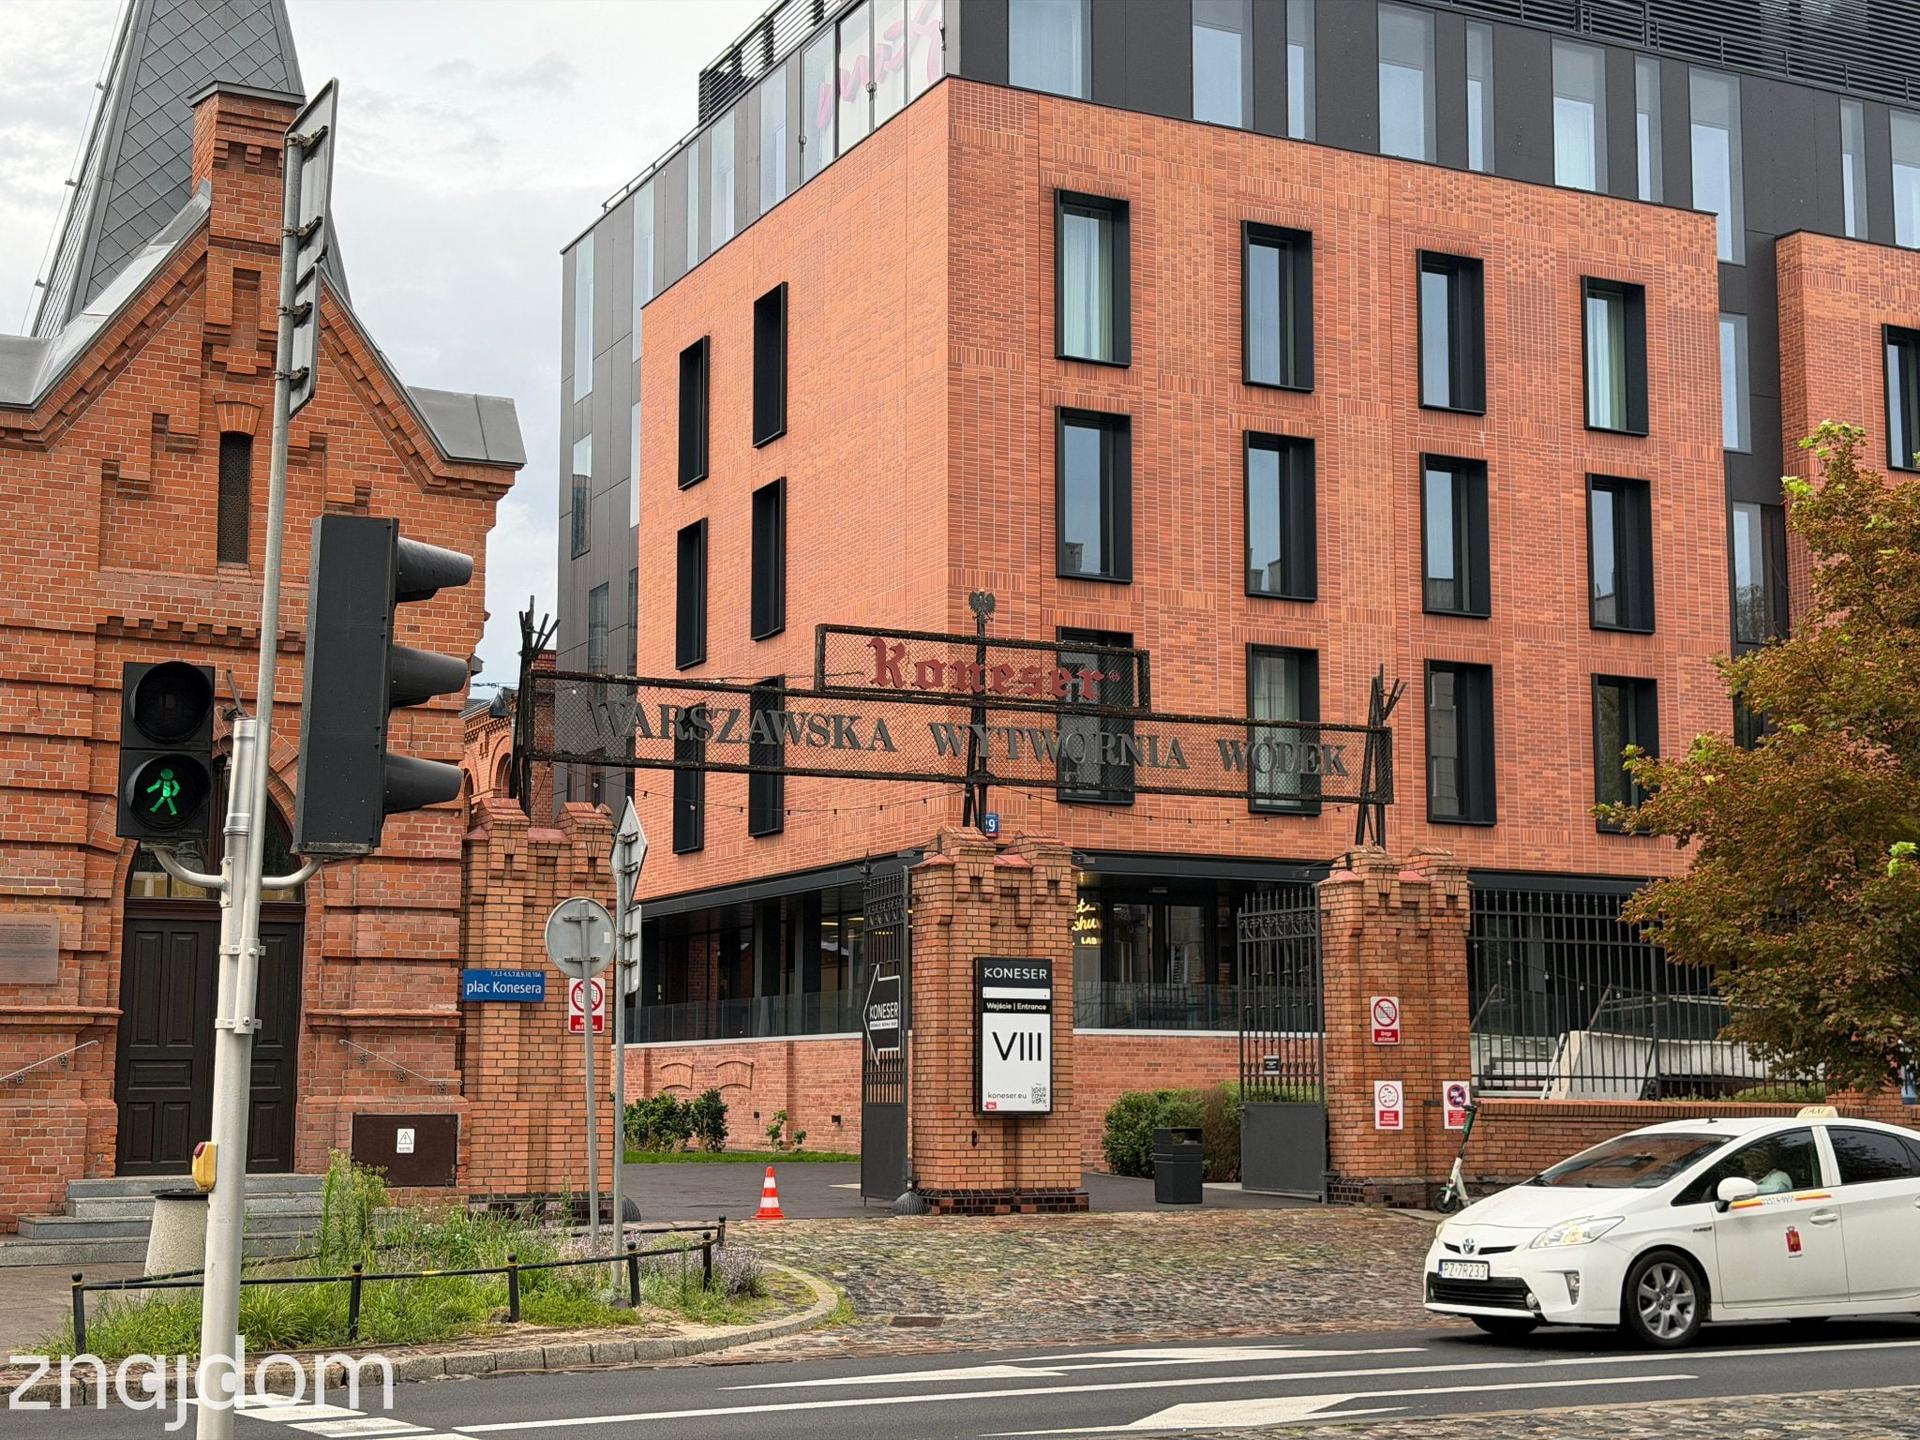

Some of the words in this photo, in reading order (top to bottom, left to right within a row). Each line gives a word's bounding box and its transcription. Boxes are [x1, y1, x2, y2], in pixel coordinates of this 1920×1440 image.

[586, 699, 897, 752] WARSZAWSKA
[984, 967, 1048, 980] KONESER
[466, 980, 490, 996] plac
[492, 980, 543, 994] Konesera
[869, 1001, 899, 1020] KONESER
[1016, 1002, 1047, 1010] Entrance
[992, 1031, 1042, 1061] VIII
[987, 1091, 1027, 1099] koneser.eu
